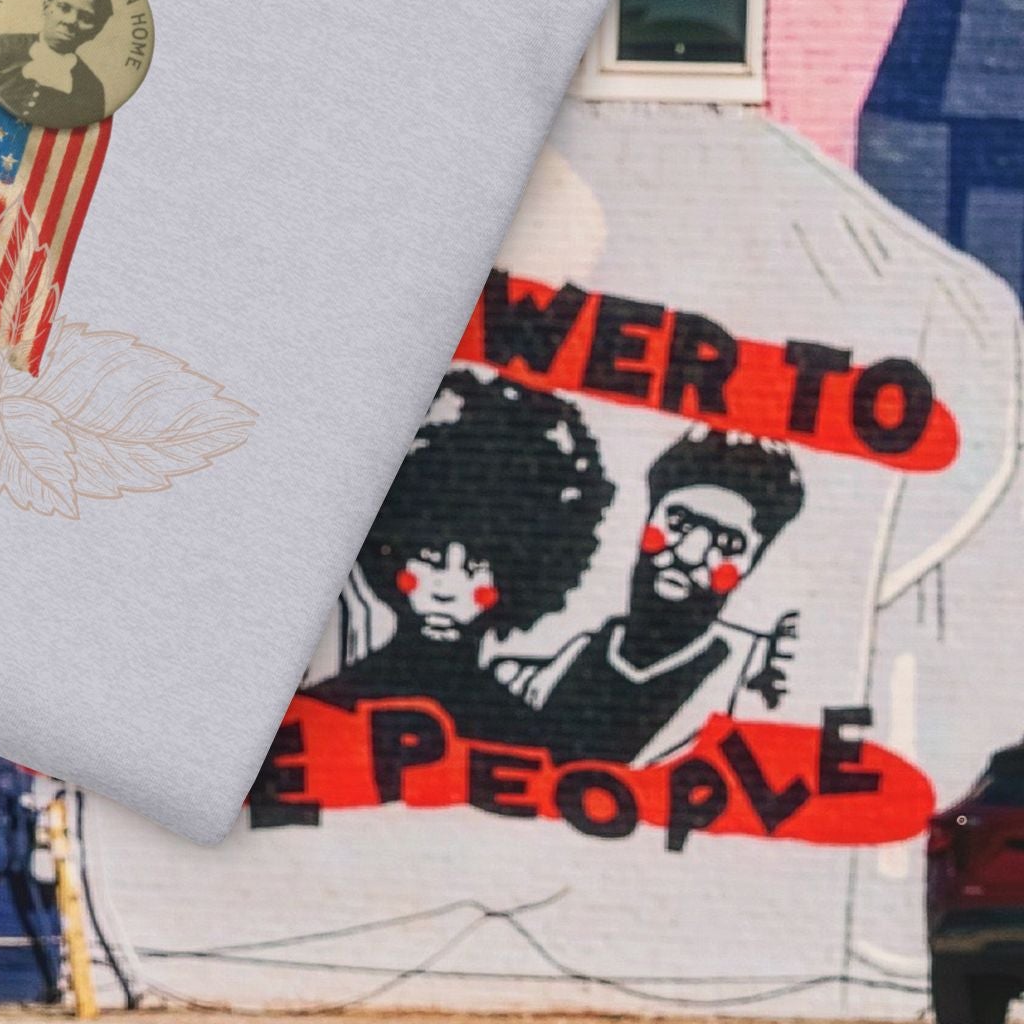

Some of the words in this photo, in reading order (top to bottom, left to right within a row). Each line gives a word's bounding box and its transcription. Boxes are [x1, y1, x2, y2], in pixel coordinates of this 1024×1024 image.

[123, 12, 149, 72] HOME
[786, 339, 935, 454] TO
[370, 705, 882, 853] PEOPLE
